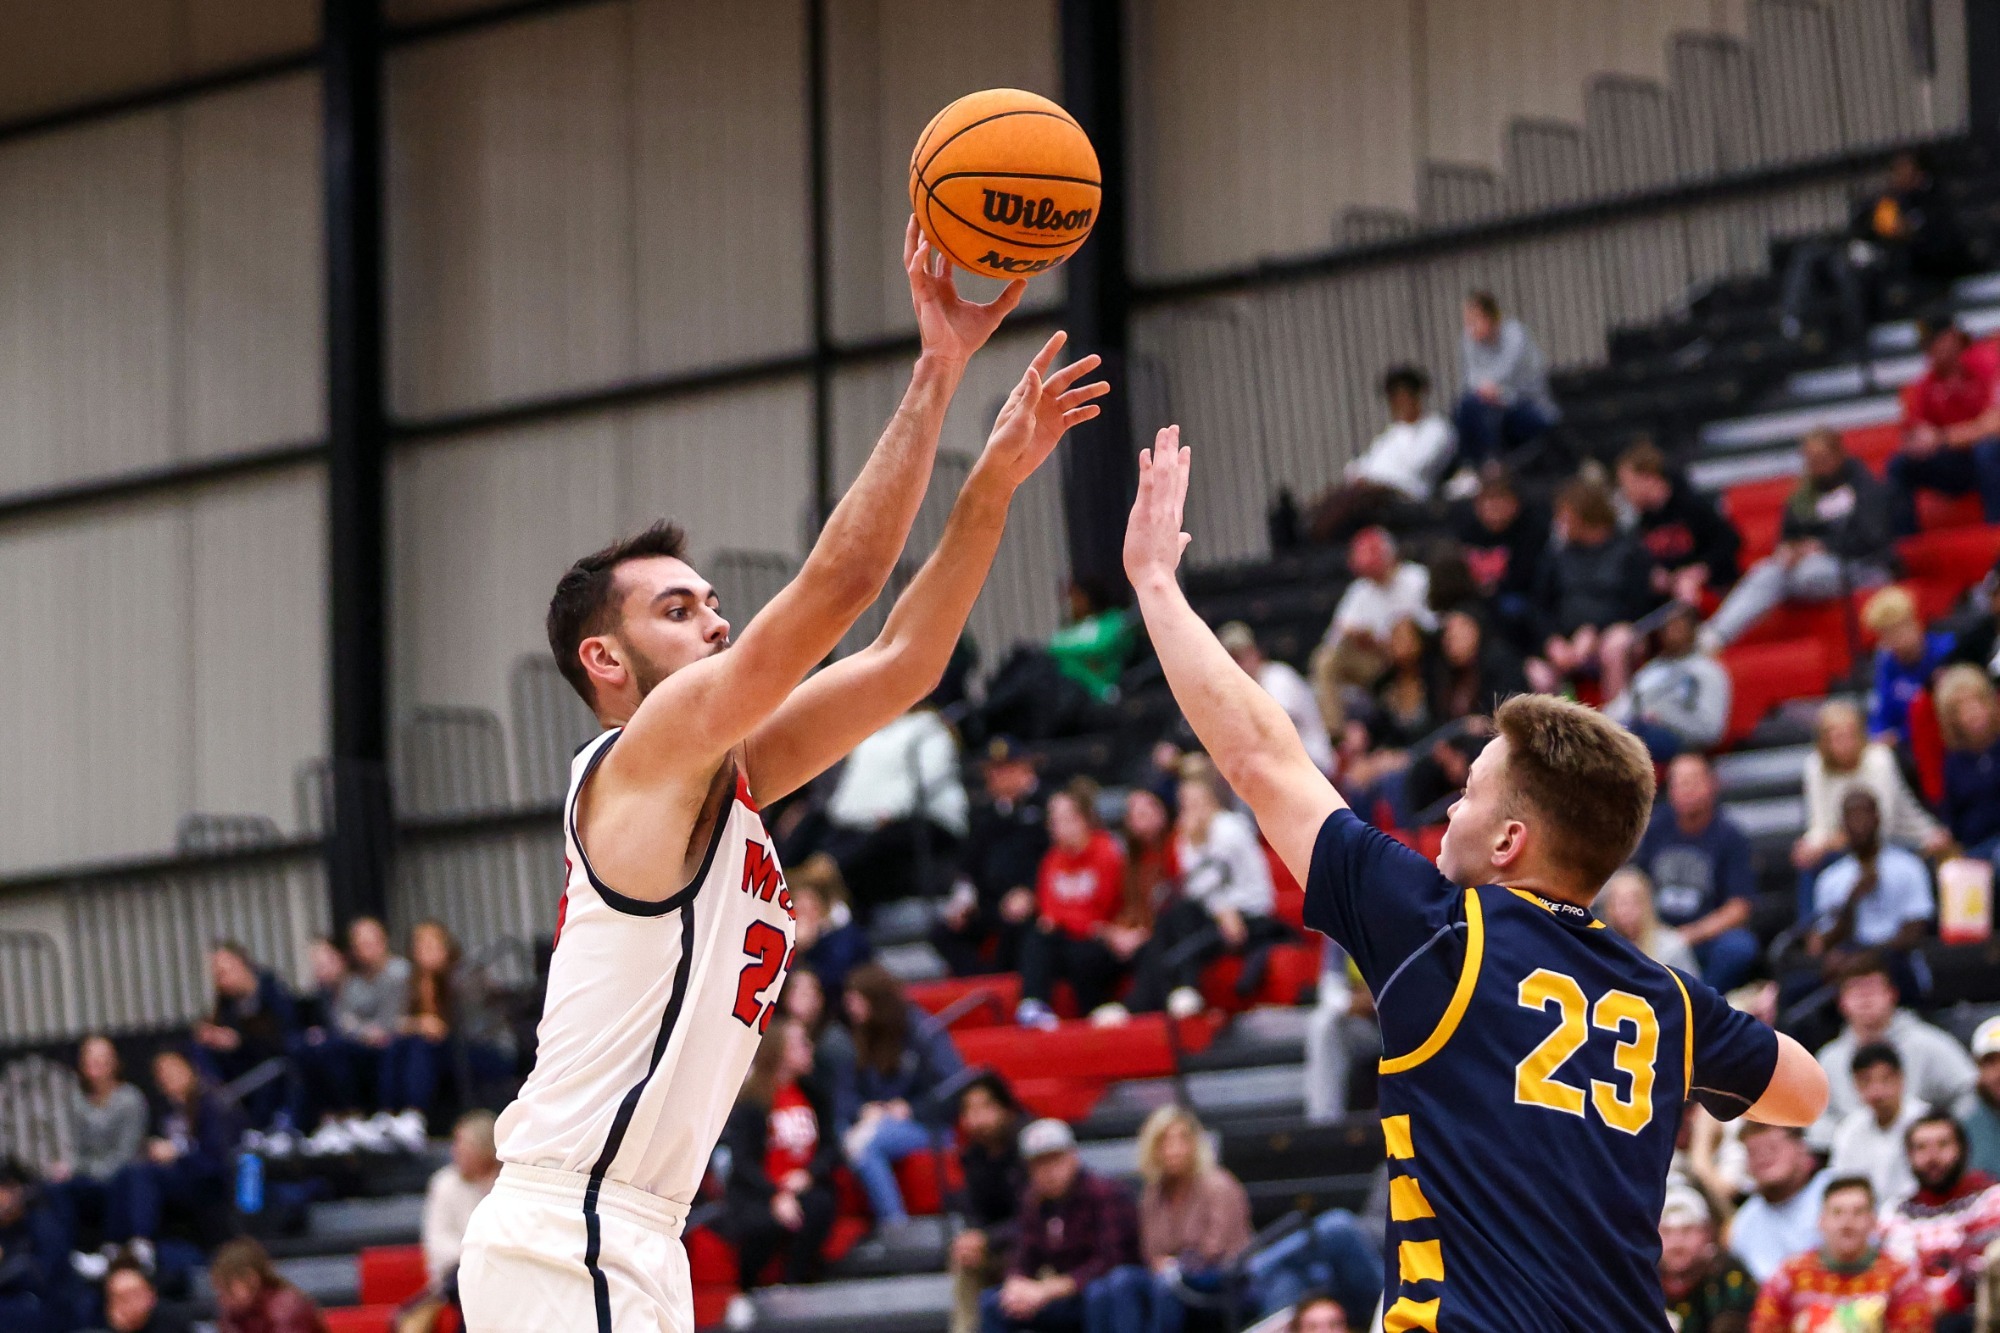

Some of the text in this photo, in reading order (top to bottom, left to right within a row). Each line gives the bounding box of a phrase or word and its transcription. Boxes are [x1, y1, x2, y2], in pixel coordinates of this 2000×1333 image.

[982, 188, 1092, 231] Wilson
[1561, 904, 1585, 917] PRO
[1514, 967, 1660, 1136] 23
